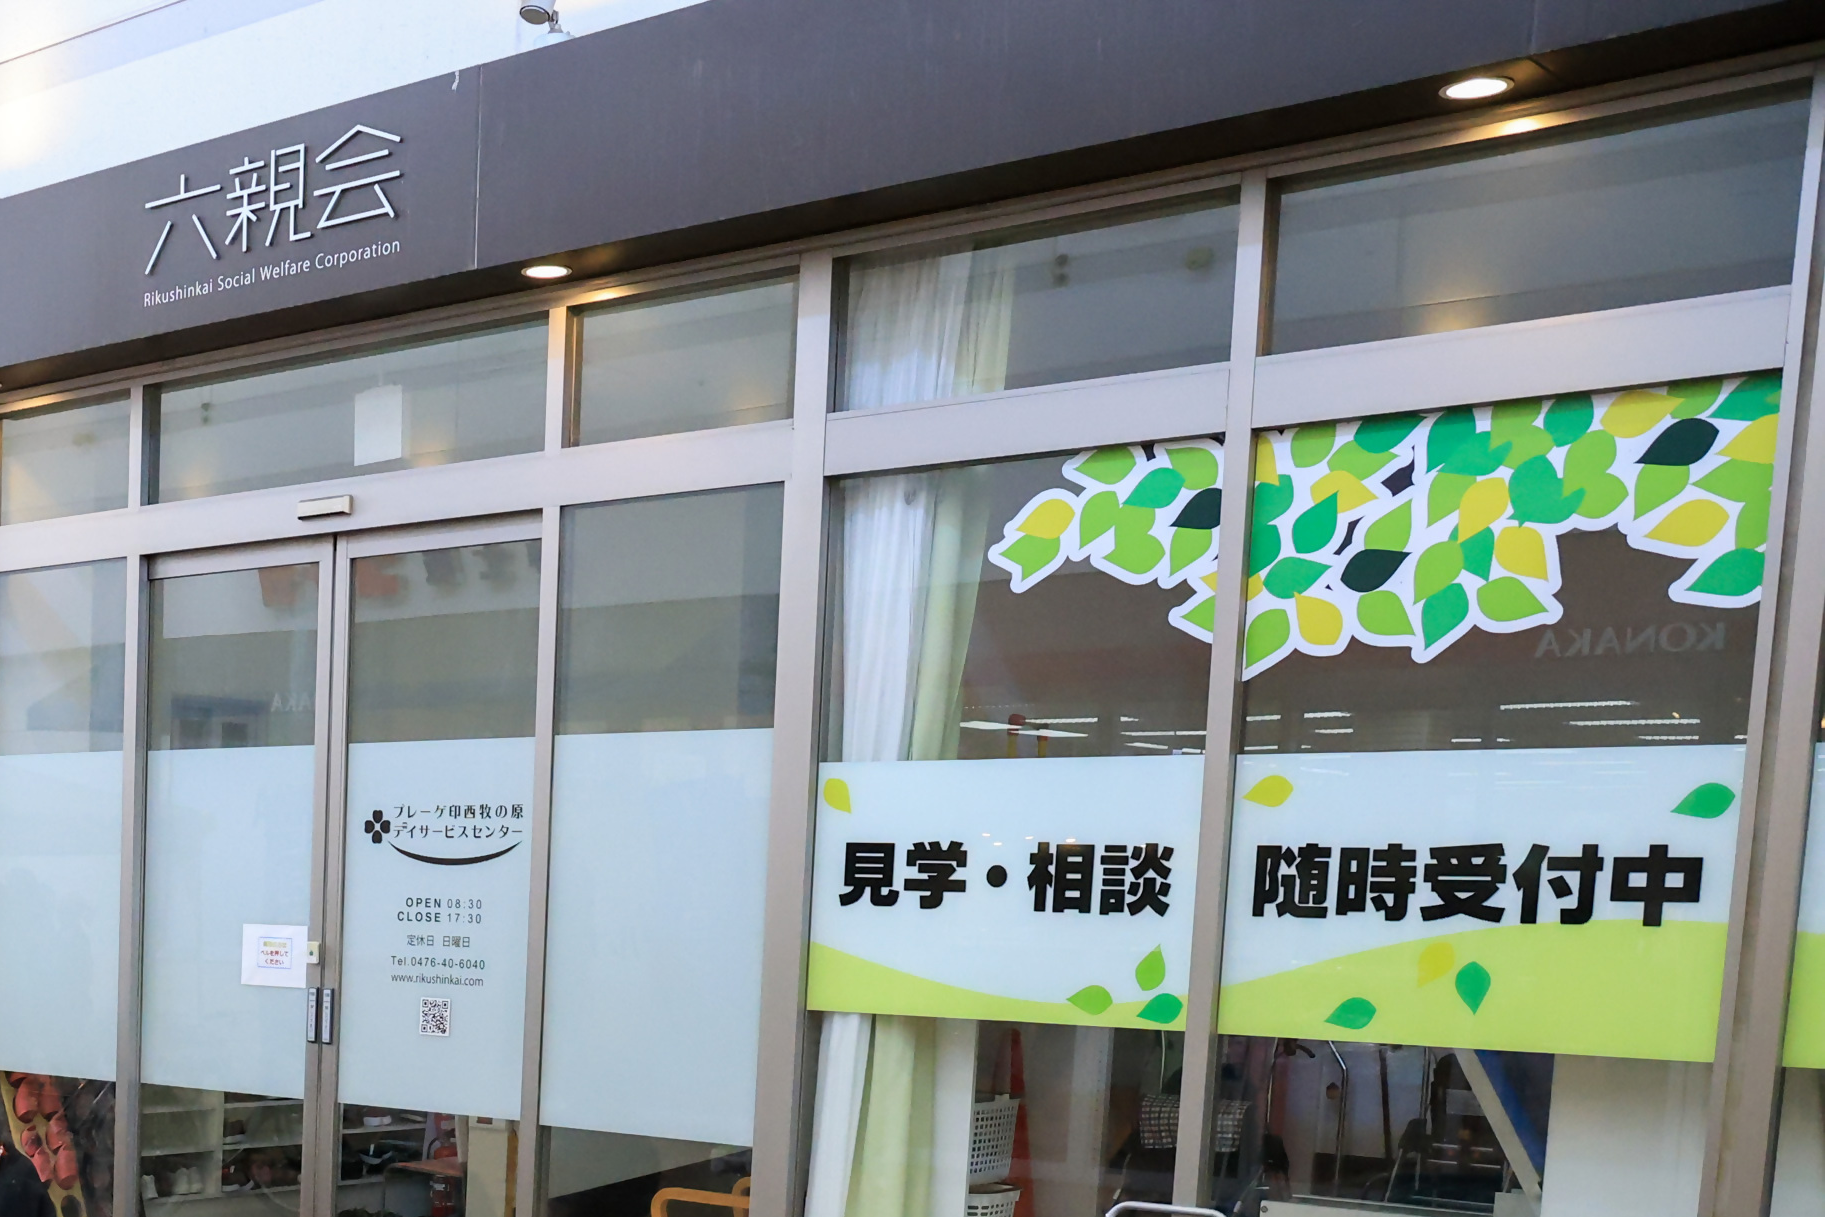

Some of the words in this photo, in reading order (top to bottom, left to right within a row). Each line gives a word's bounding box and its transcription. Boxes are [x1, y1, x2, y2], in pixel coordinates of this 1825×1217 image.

[144, 124, 402, 276] 六親会
[143, 280, 213, 308] Rikushinkai
[217, 267, 255, 291] Social
[260, 257, 311, 282] Welfare
[315, 240, 401, 271] Corporation
[393, 822, 523, 839] デイサービスセンター
[837, 840, 1176, 918] 見学・相談
[1251, 842, 1705, 928] 随時受付中
[405, 897, 442, 908] OPEN
[446, 898, 482, 909] 08:30
[397, 911, 442, 922] CLOSE
[447, 912, 482, 924] 17:30
[406, 934, 435, 947] 定休日
[442, 935, 471, 948] 日曜日
[390, 955, 486, 970] Tel.0476-40-6040
[390, 973, 484, 987] www.rikushinkai.com
